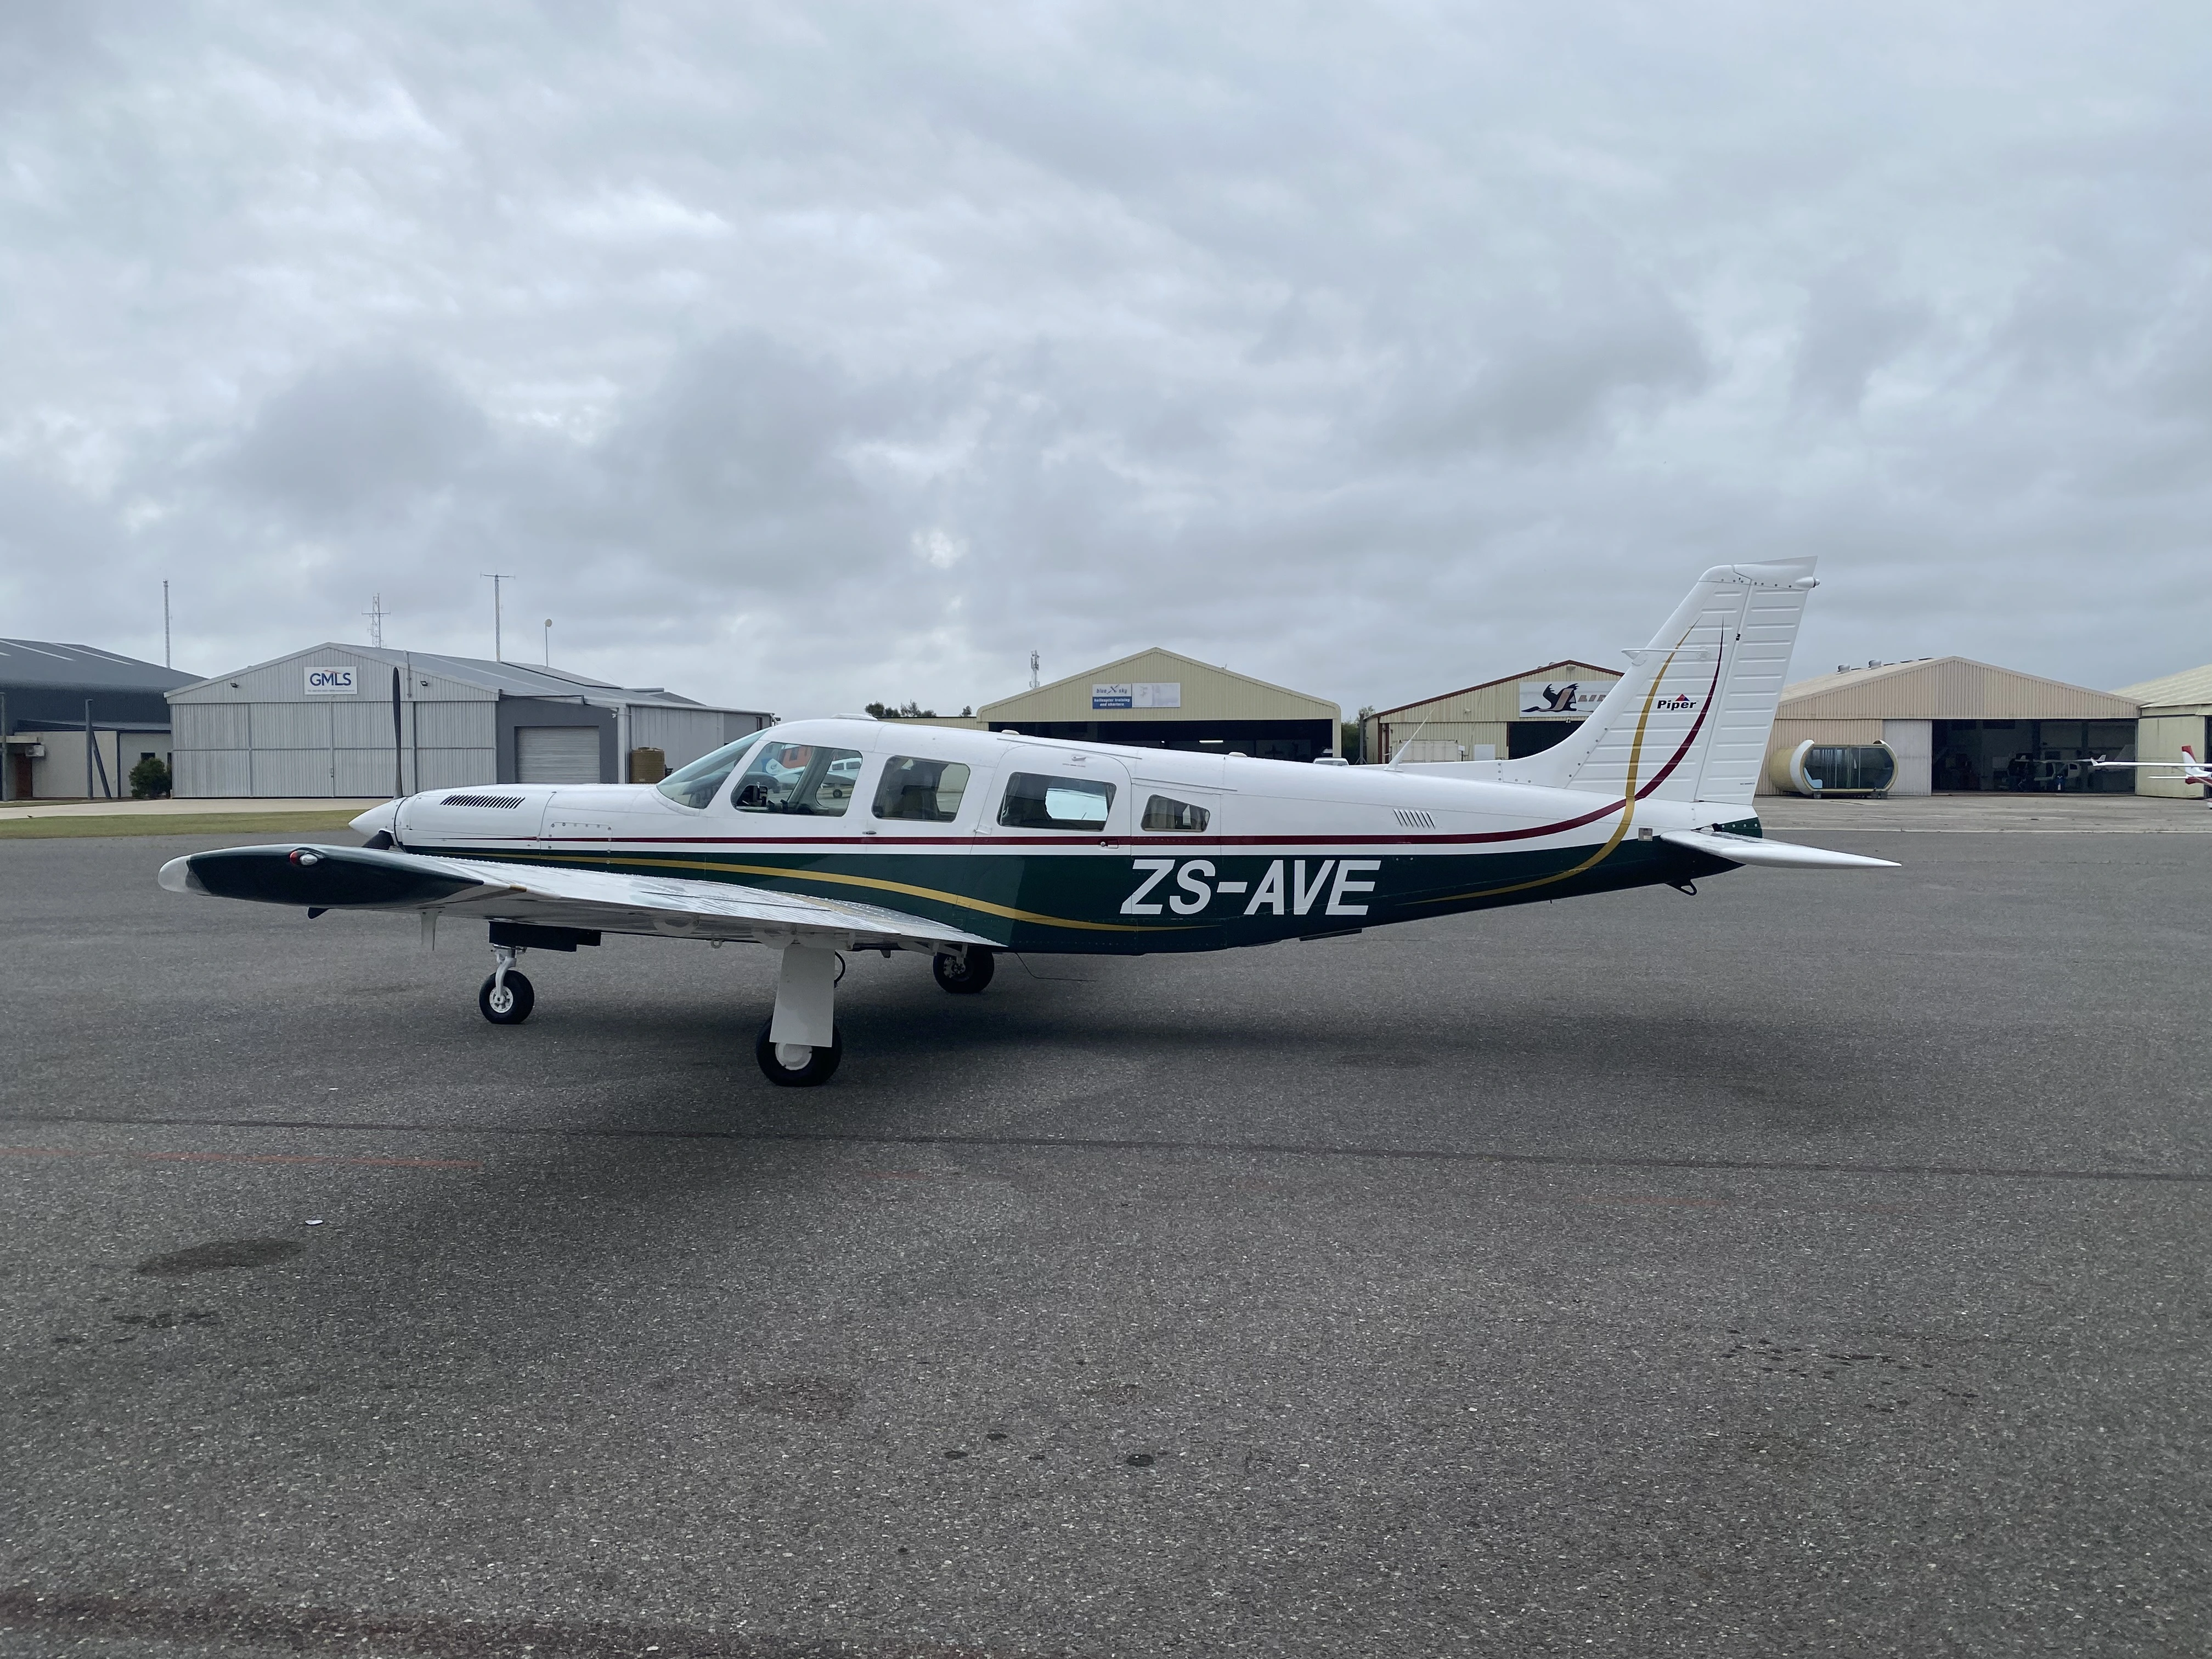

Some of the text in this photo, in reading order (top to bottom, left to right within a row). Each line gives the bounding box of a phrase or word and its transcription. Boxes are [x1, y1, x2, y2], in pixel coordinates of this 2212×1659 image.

[310, 673, 351, 686] GMLS
[1657, 699, 1697, 711] Piper
[1119, 859, 1382, 916] ZS-AVE
